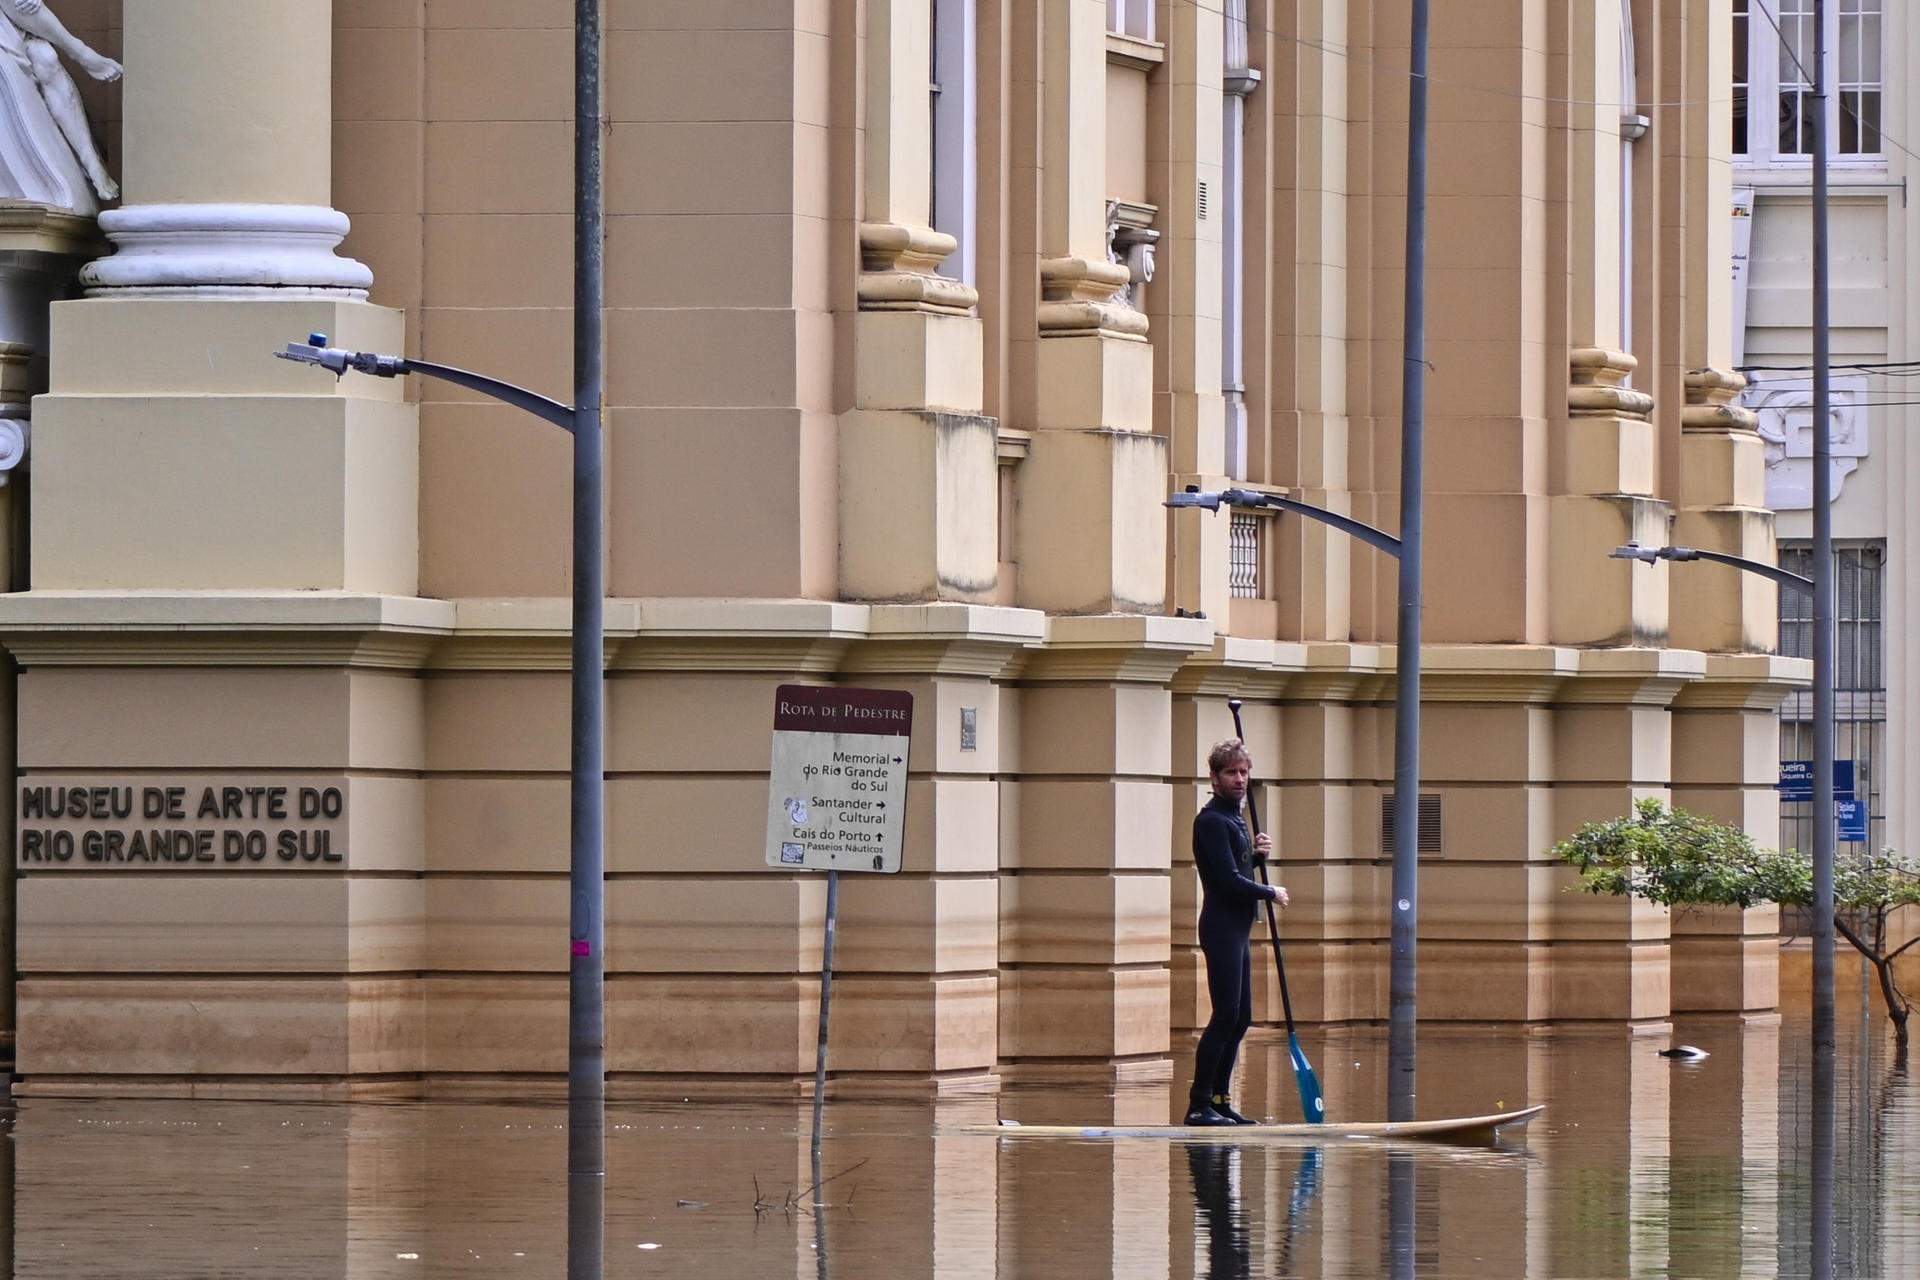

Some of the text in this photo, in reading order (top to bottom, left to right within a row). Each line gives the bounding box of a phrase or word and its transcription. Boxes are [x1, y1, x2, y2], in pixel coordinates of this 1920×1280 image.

[833, 752, 889, 765] Memorial
[803, 764, 888, 778] do Rio Grande
[851, 780, 888, 792] do Sul
[22, 786, 343, 819] MUSEU DE ARTE DO
[811, 796, 872, 810] Santander
[838, 812, 886, 824] Cultural
[792, 828, 871, 842] Cais do Porto
[22, 828, 344, 862] RIO GRANDE DO SUL
[807, 842, 843, 851] Passeios
